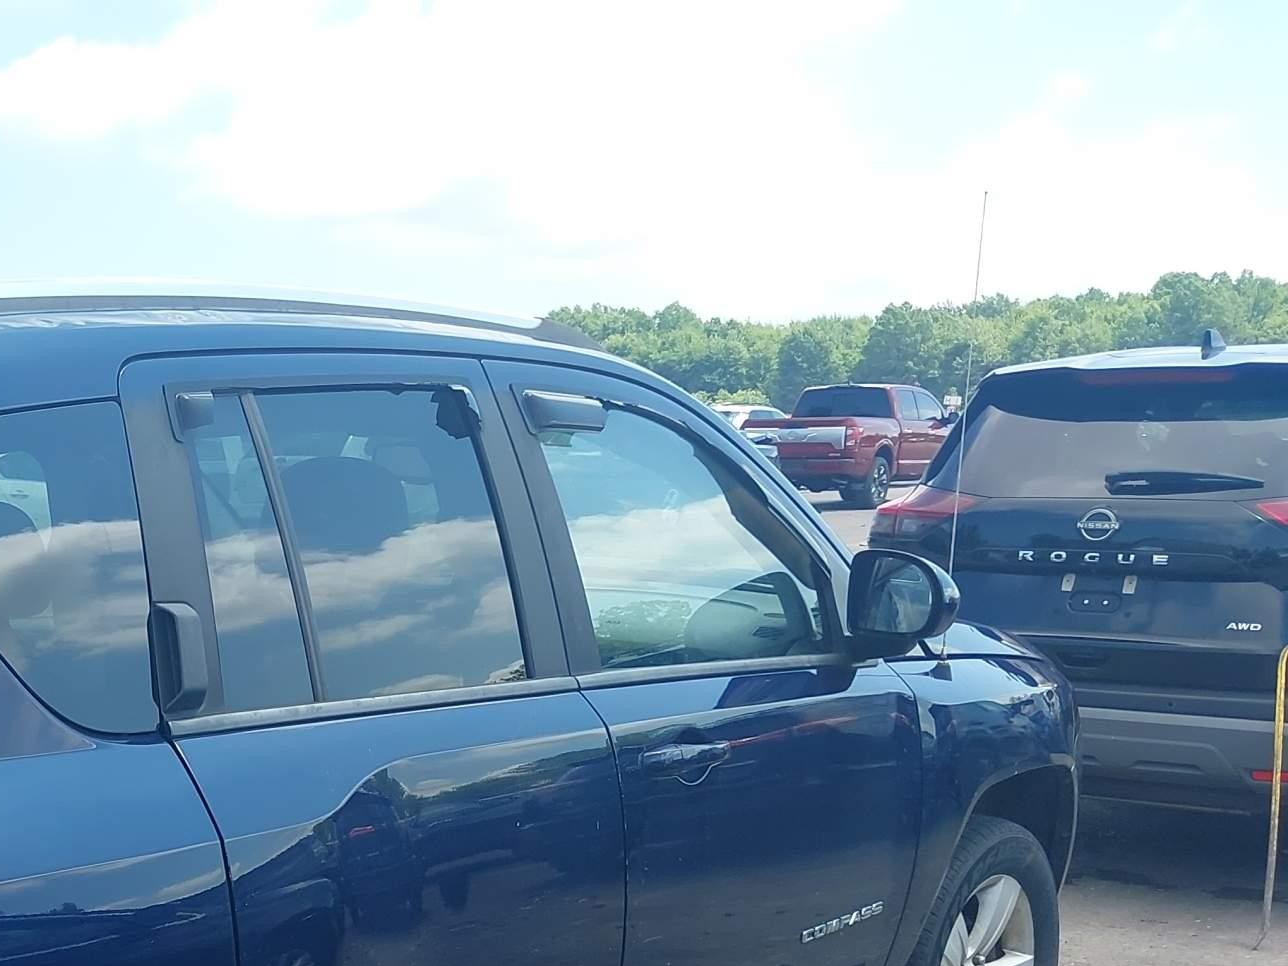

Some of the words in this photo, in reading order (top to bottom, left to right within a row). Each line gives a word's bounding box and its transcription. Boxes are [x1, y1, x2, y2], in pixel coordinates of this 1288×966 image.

[1077, 521, 1120, 530] NISSAN
[1018, 550, 1169, 566] ROGUE
[1226, 622, 1262, 632] AWD
[802, 901, 884, 943] COMPASS
